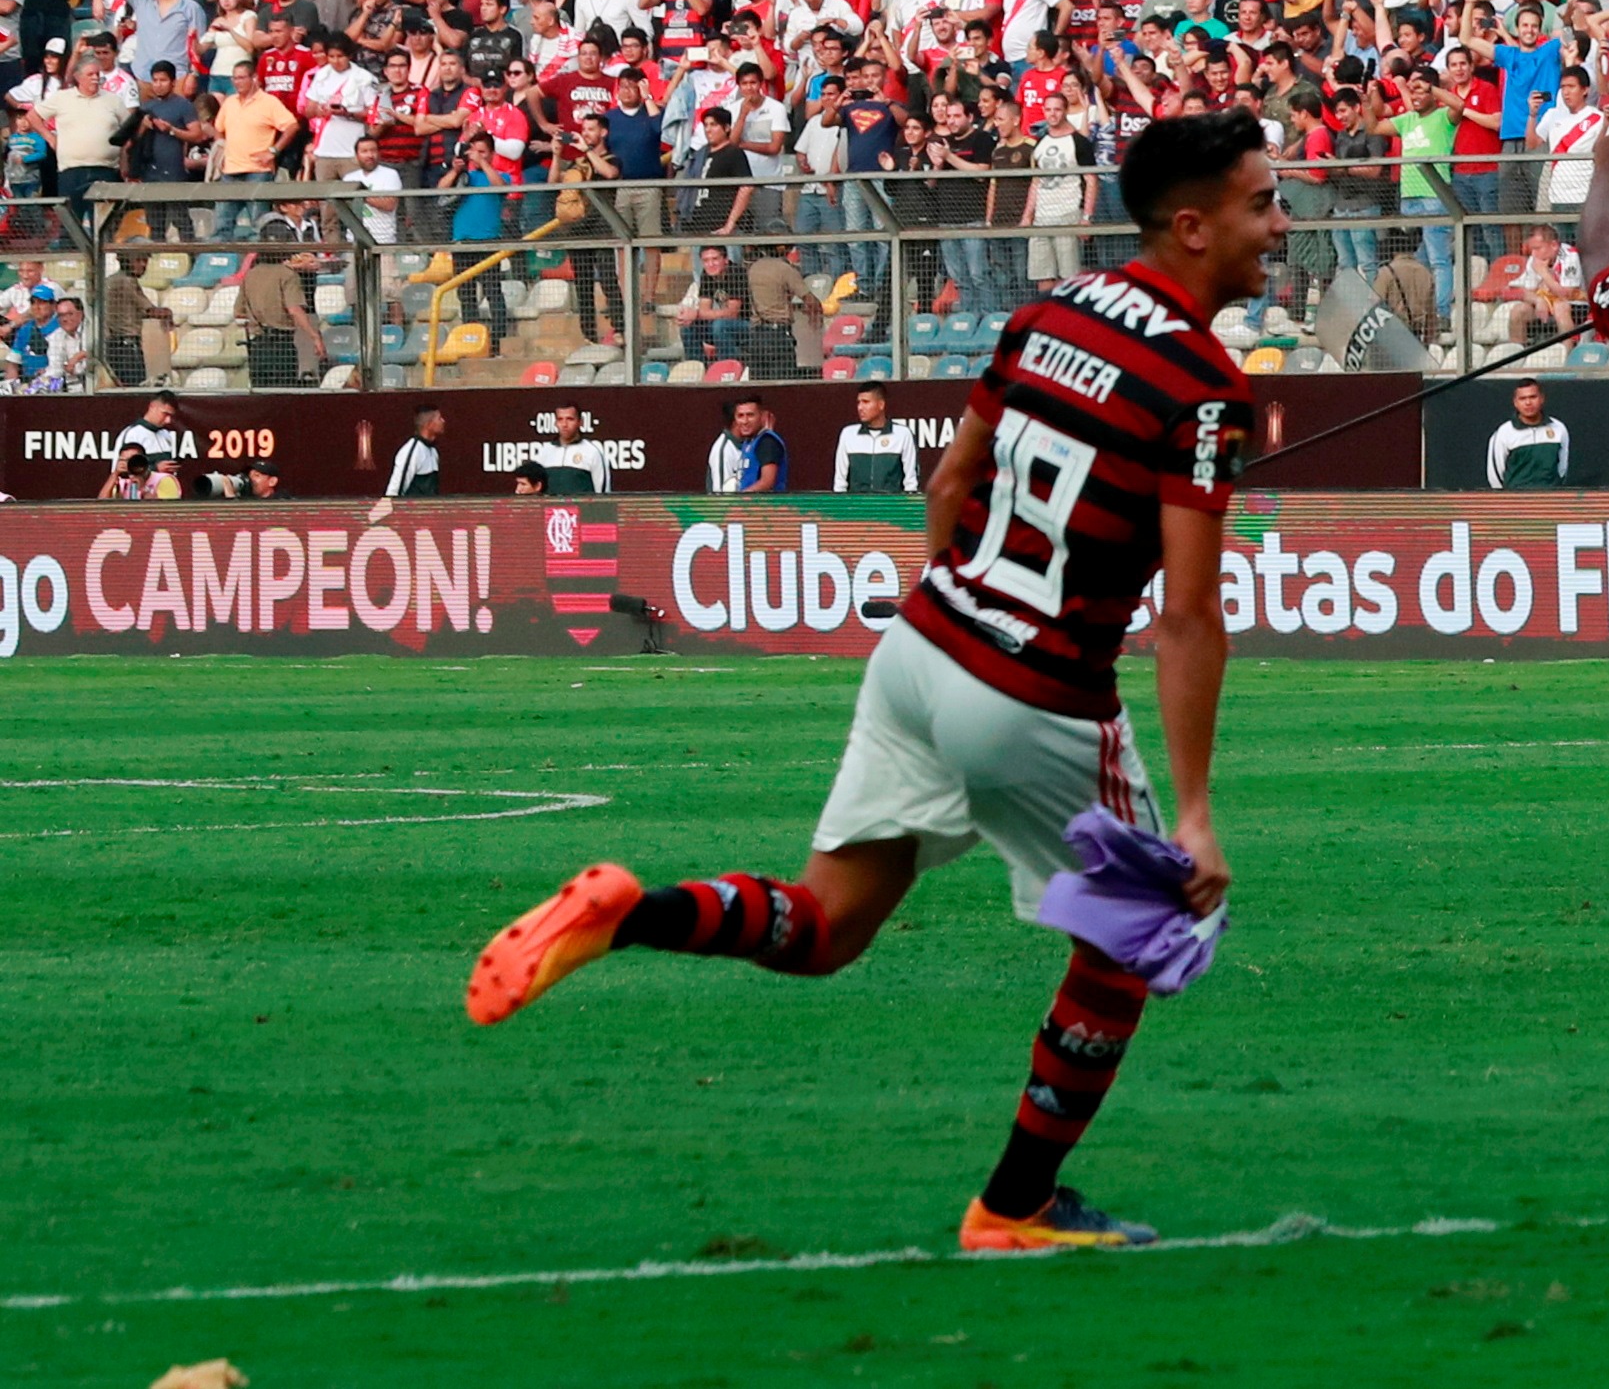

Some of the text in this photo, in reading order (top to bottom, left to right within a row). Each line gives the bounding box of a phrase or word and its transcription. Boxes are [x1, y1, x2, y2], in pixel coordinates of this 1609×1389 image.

[1120, 112, 1151, 132] bs2
[1074, 273, 1191, 337] MRV
[25, 430, 116, 460] FINAL
[207, 428, 275, 459] 2019
[1192, 401, 1226, 494] buser
[956, 407, 1098, 618] 19
[85, 497, 496, 634] CAMPEÓN!
[672, 522, 901, 633] Clube
[1419, 521, 1533, 636] do
